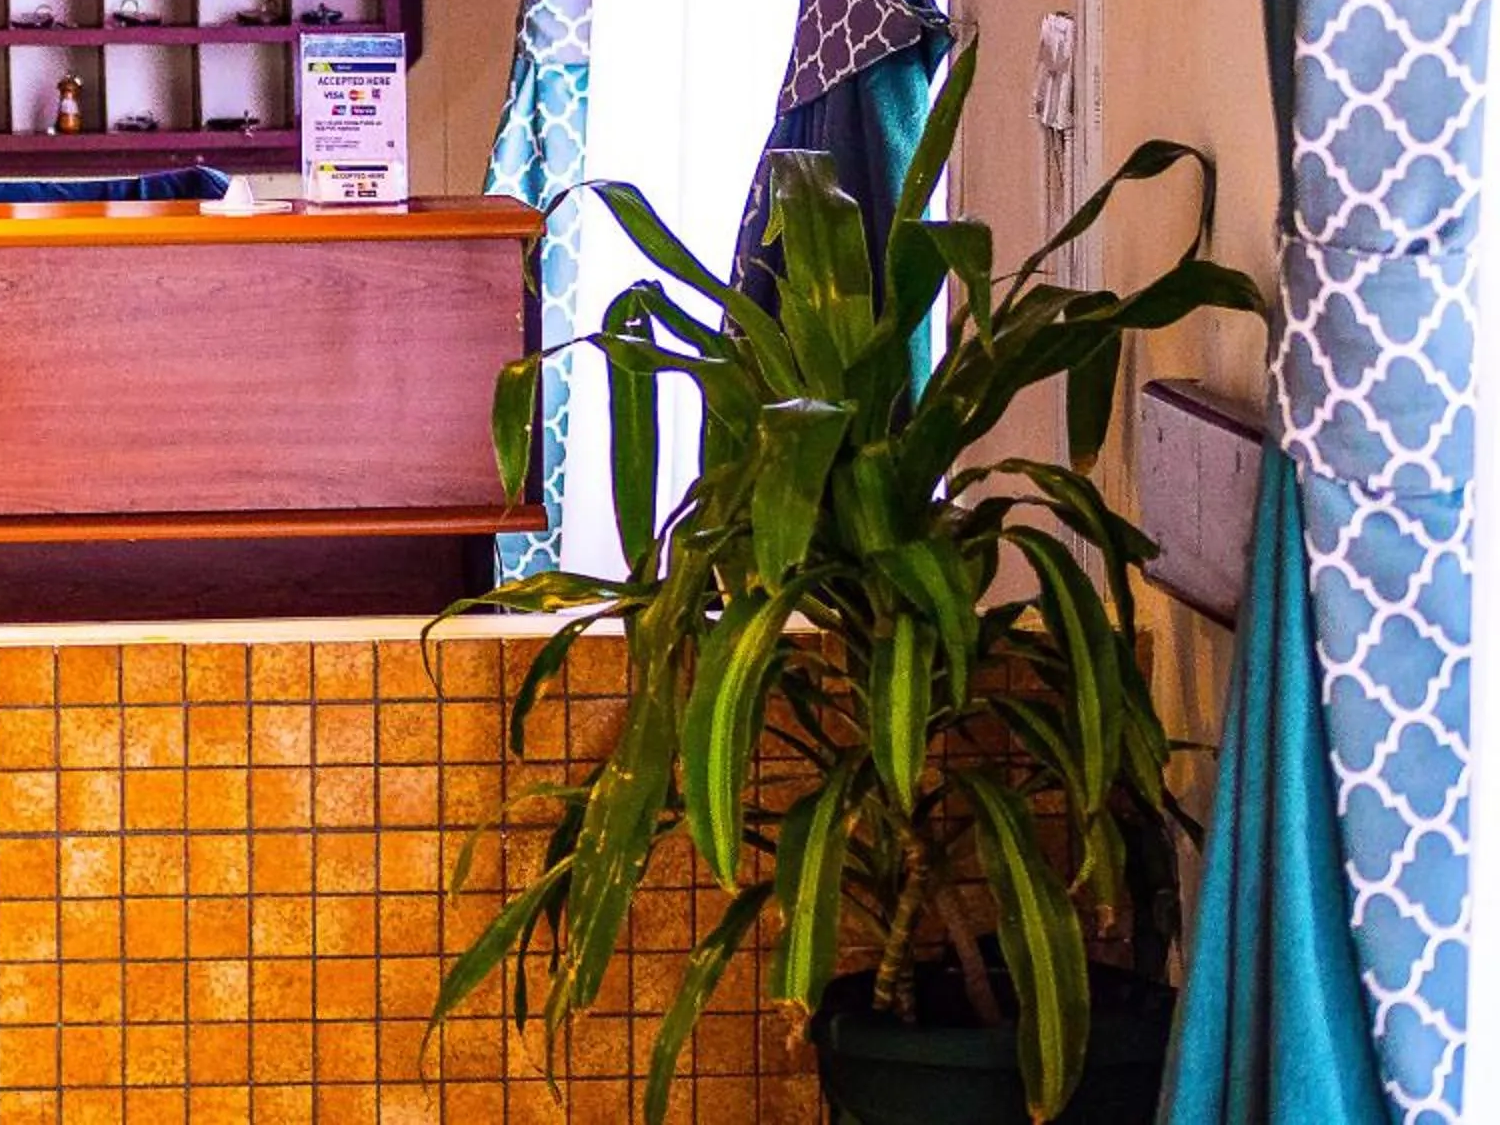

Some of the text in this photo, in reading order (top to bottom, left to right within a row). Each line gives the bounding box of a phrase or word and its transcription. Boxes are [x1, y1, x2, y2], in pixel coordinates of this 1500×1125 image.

[318, 77, 391, 86] ACCEPTED HERE
[324, 91, 345, 100] VISA
